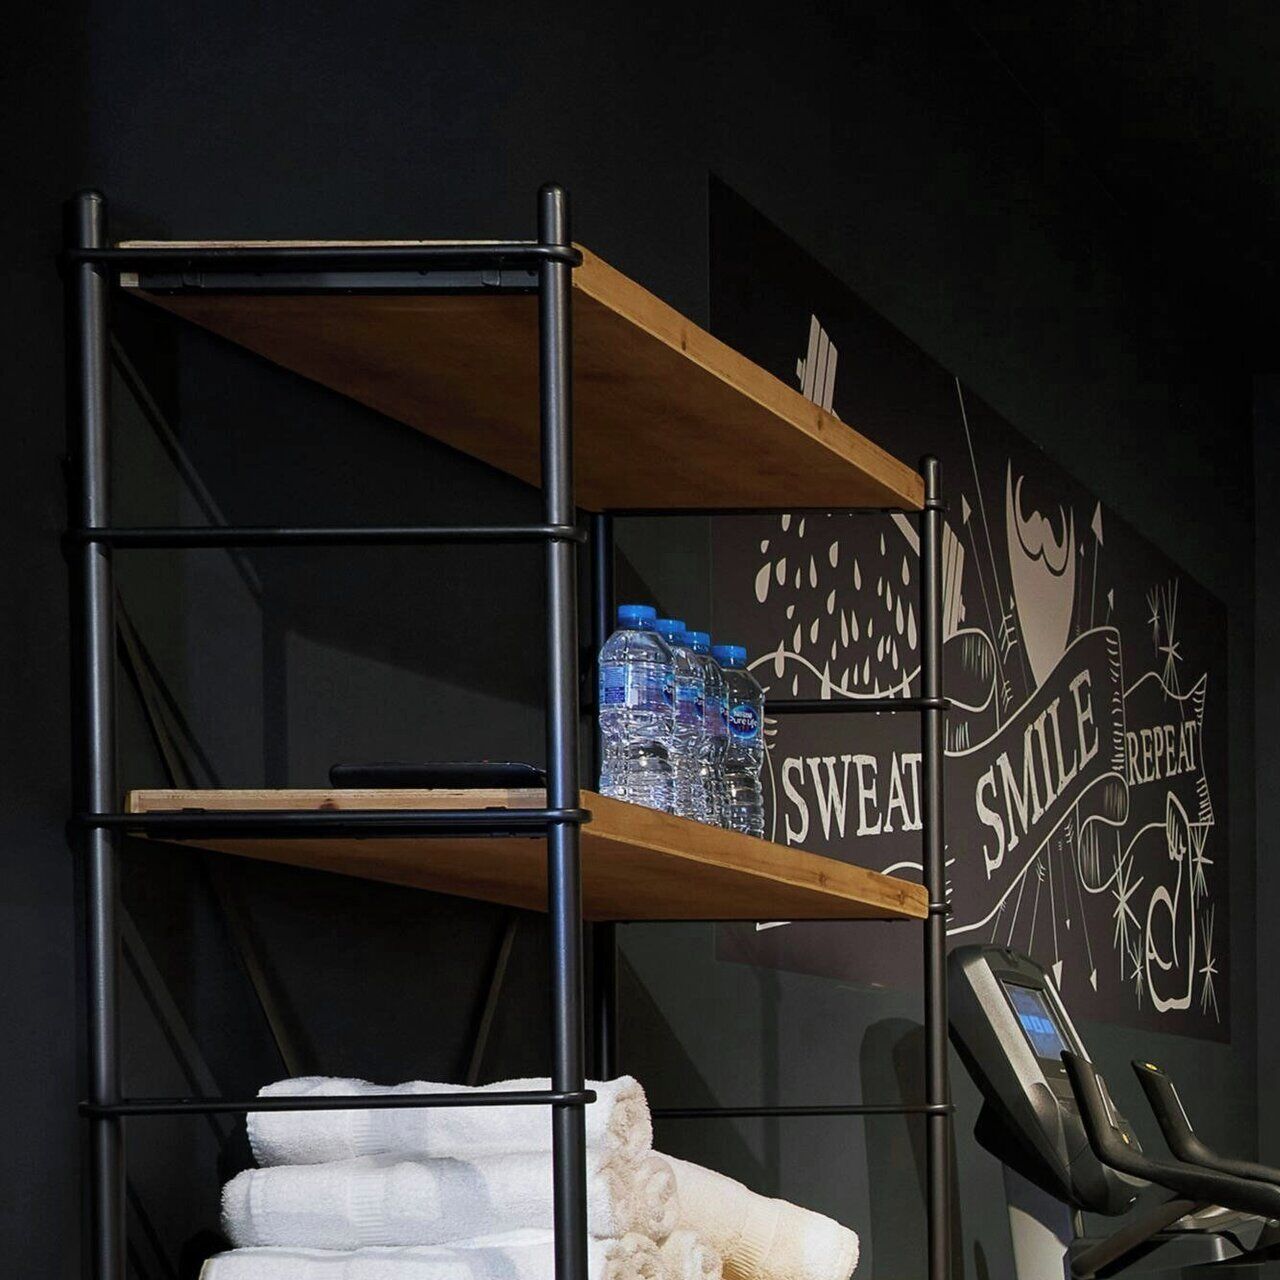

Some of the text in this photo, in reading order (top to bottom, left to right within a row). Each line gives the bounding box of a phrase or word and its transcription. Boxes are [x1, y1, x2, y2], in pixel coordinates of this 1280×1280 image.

[781, 669, 1199, 881] SWEAT SMILE REPEAT
